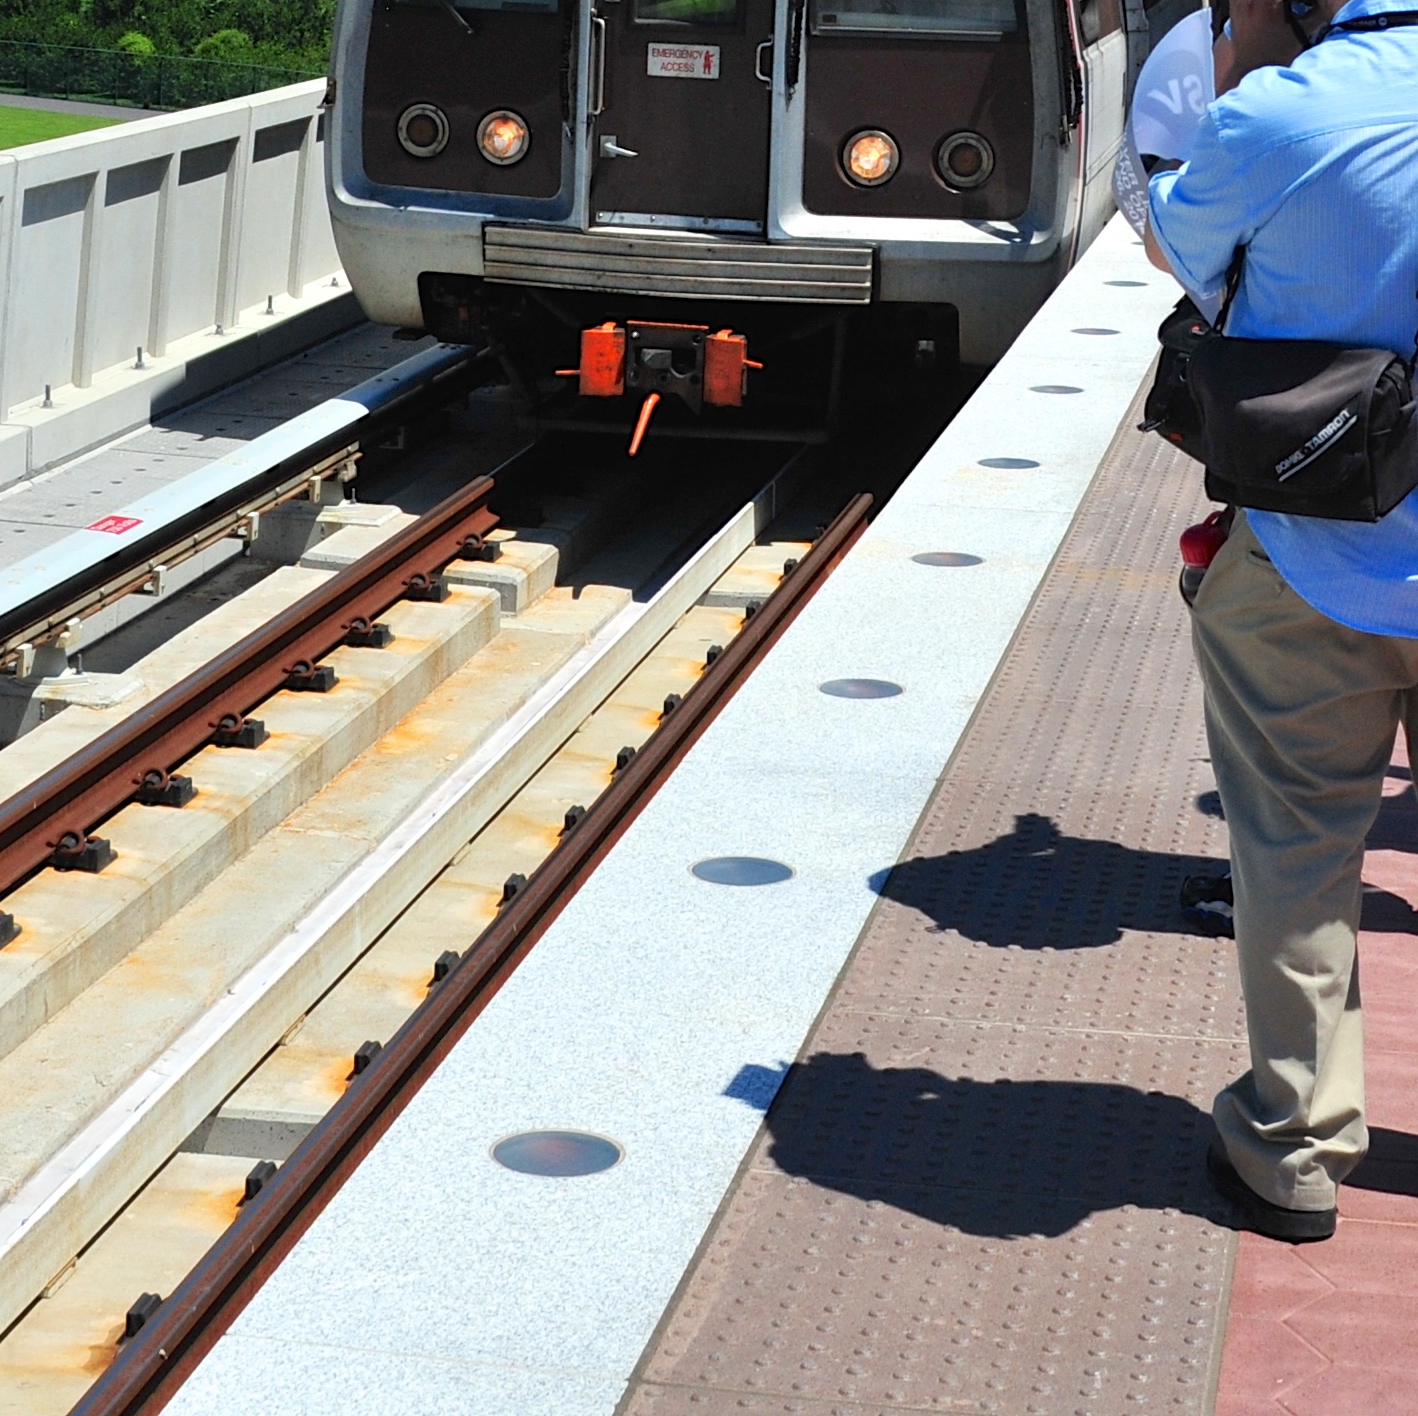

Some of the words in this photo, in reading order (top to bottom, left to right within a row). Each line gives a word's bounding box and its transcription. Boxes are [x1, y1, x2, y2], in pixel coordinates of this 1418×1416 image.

[651, 48, 703, 60] EMERGENCY
[660, 62, 695, 73] ACCESS
[1304, 408, 1350, 451] TAMRON
